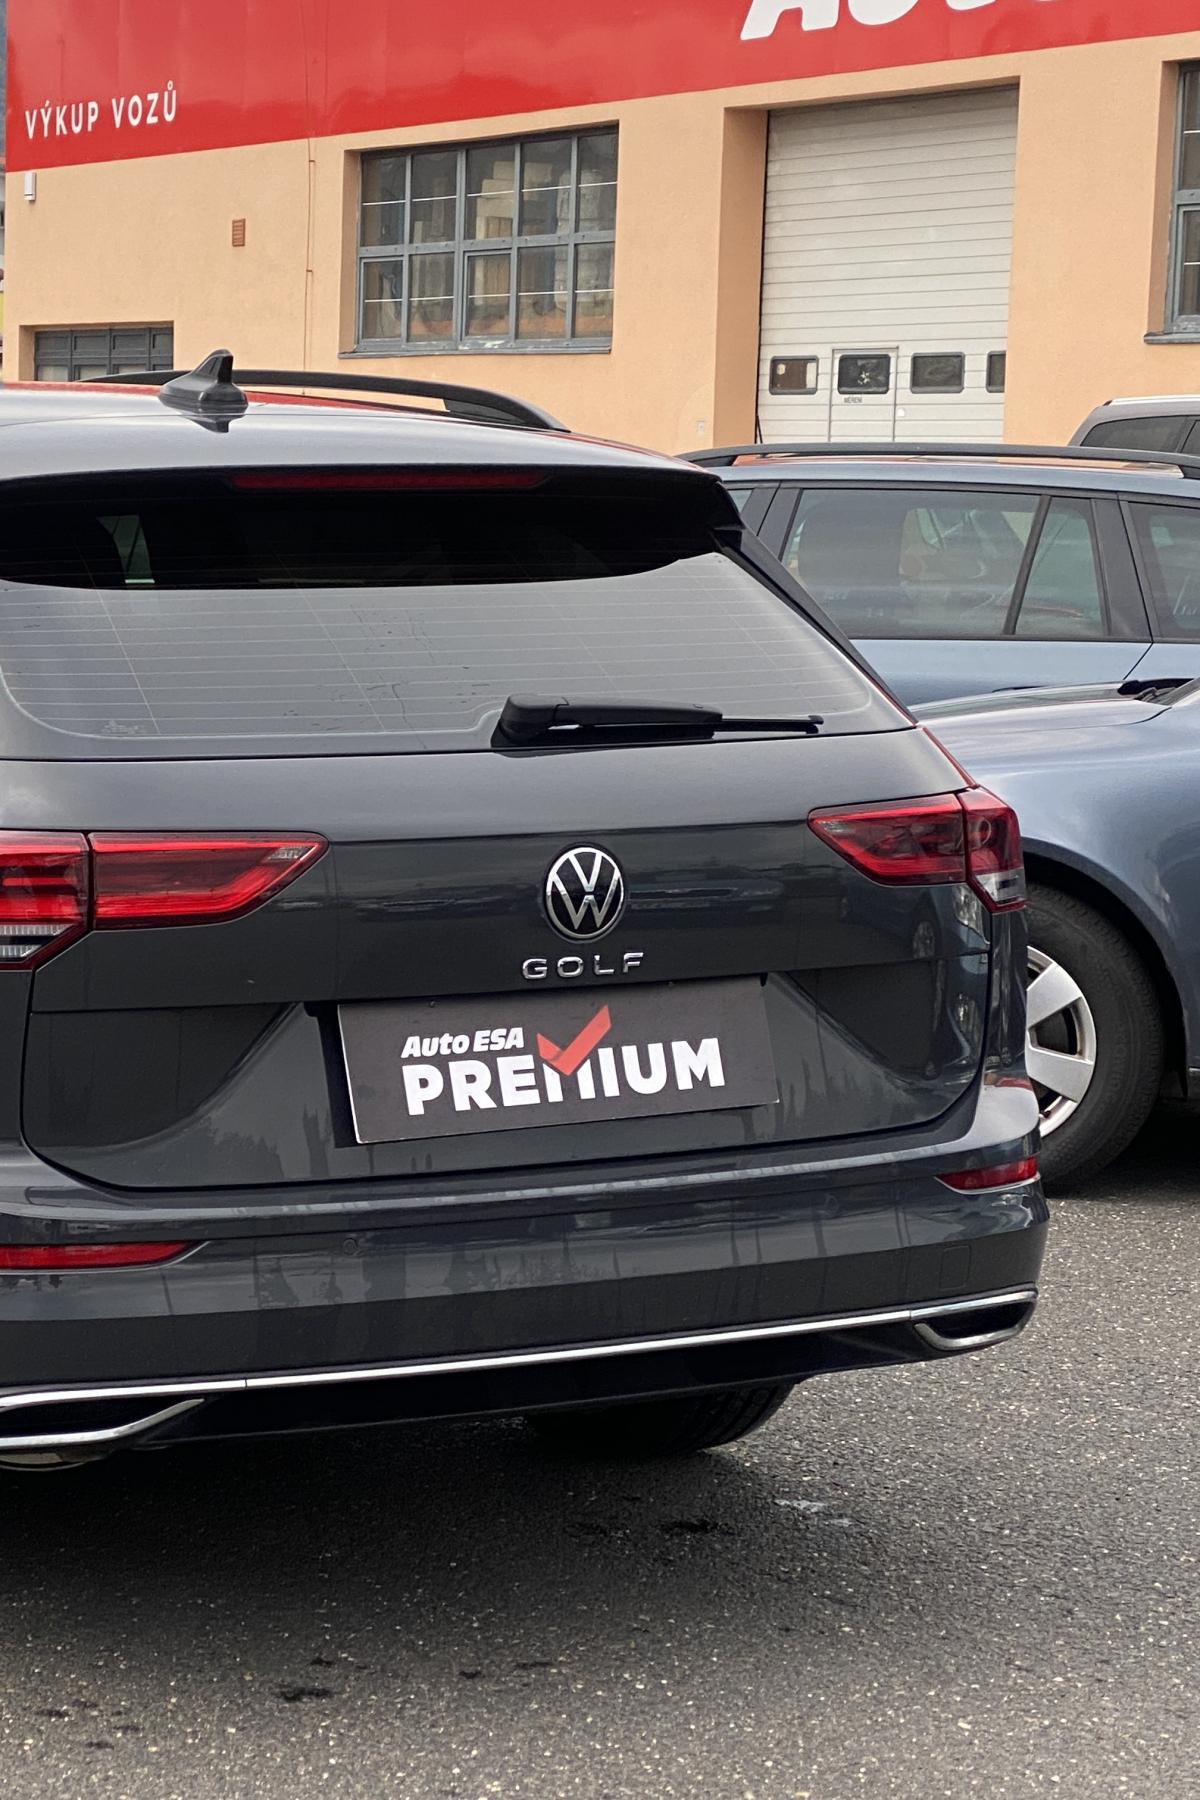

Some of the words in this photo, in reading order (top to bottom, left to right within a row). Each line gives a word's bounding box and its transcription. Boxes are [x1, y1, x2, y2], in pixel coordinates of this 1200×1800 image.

[25, 99, 99, 139] VÝKUP
[111, 80, 176, 129] VOZŮ
[522, 952, 644, 980] GOLF
[401, 1032, 472, 1058] Auto
[472, 1027, 525, 1052] ESA
[401, 1037, 726, 1116] PREMIUM
